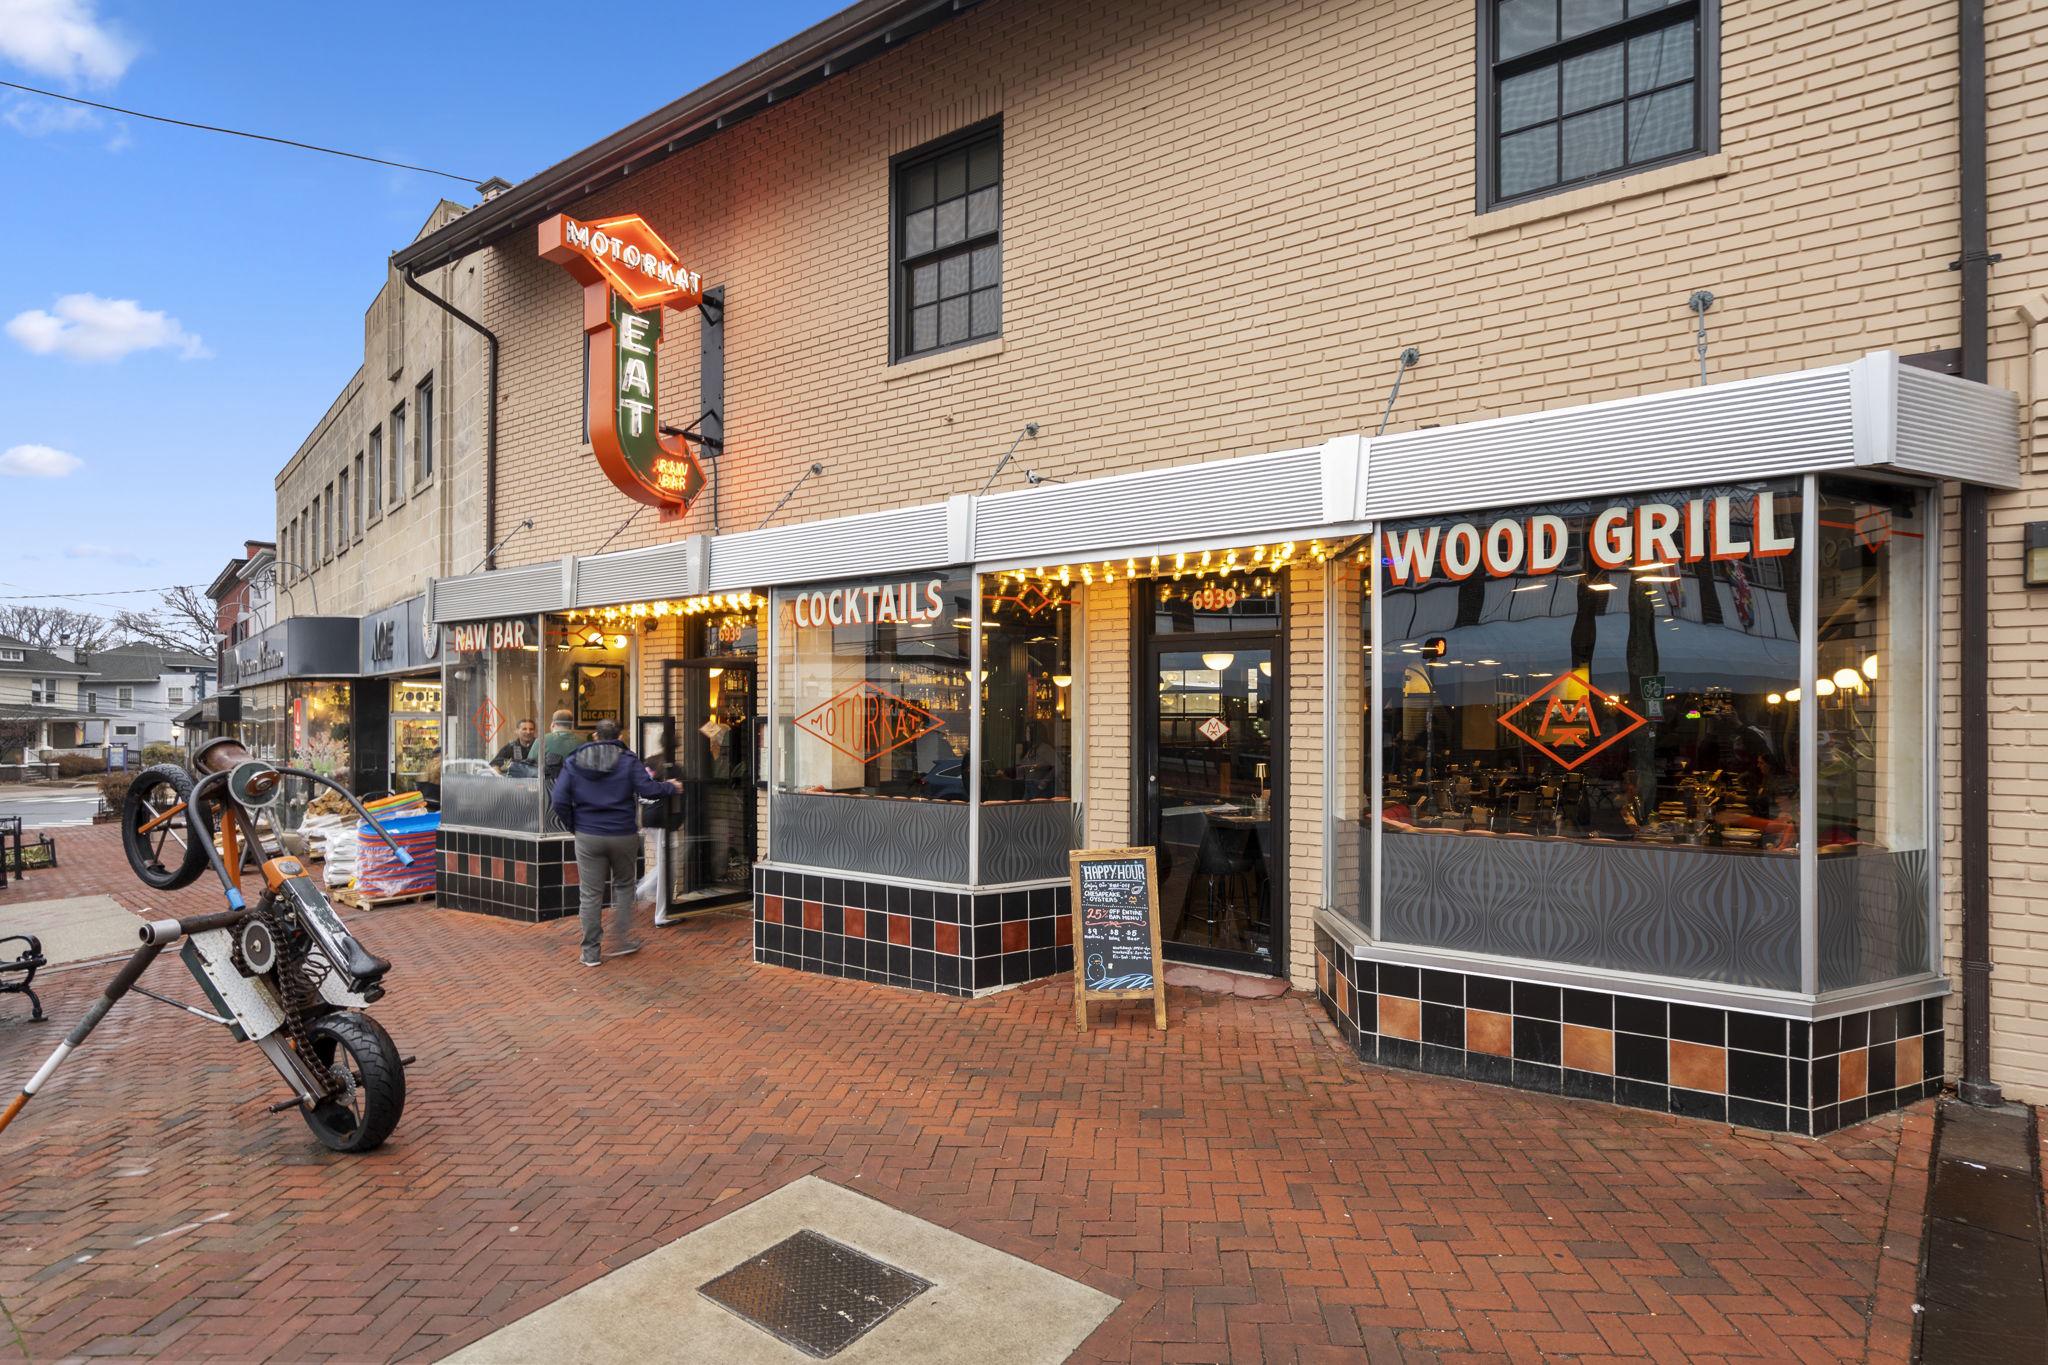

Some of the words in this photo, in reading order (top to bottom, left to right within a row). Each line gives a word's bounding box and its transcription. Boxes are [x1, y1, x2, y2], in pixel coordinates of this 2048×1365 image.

[566, 220, 701, 296] MOTORKAT
[620, 312, 654, 438] EAT
[656, 458, 689, 476] RAW
[658, 473, 686, 491] BAR
[1384, 513, 1569, 586] WOOD
[1588, 491, 1797, 572] GRILL
[793, 579, 944, 628] COCKTAILS
[1191, 587, 1238, 611] 6939
[454, 622, 489, 652] RAW
[492, 620, 525, 652] BAR
[718, 626, 742, 642] 6939
[810, 692, 922, 753] MOTORKAT
[1083, 864, 1117, 880] HAPPY
[1117, 864, 1146, 880] HOUR
[1086, 908, 1109, 920] 25%
